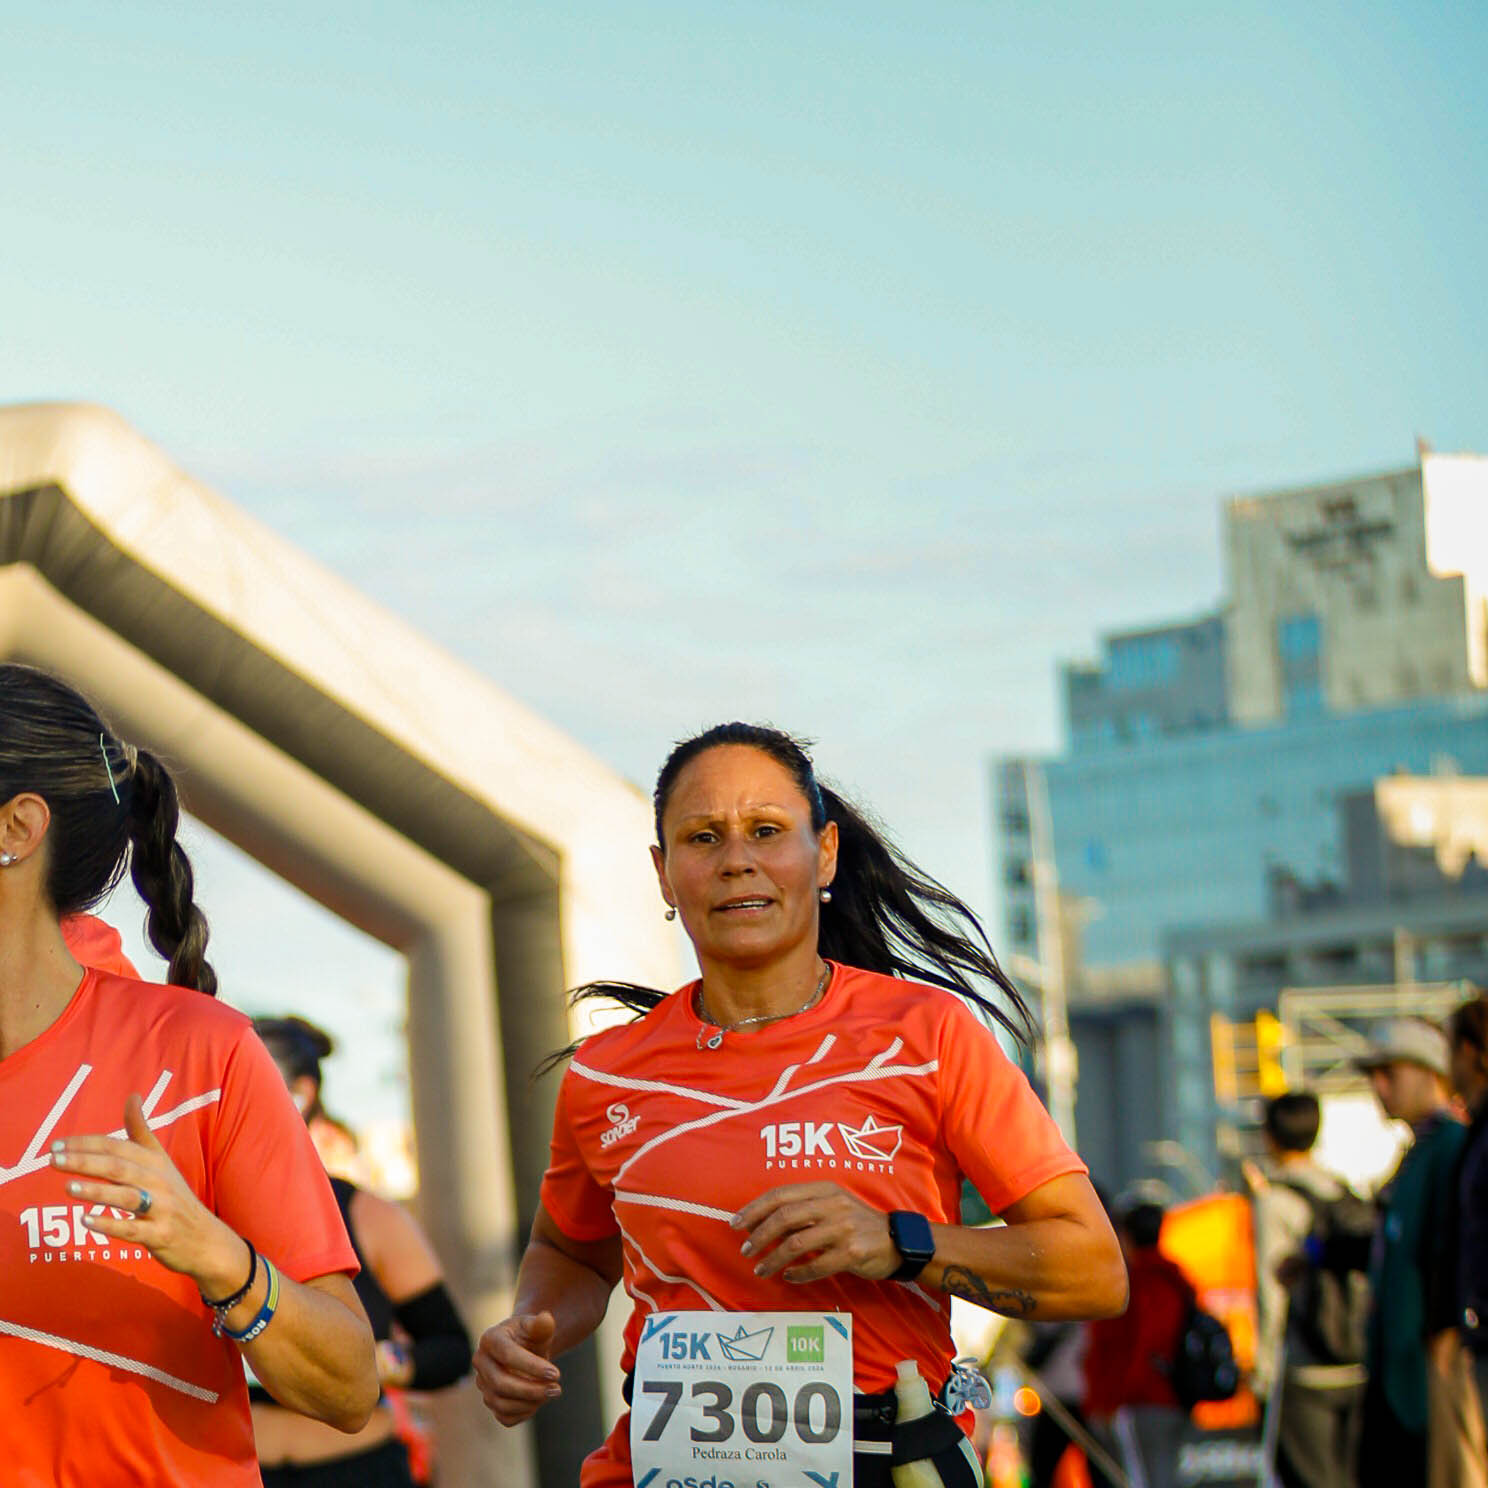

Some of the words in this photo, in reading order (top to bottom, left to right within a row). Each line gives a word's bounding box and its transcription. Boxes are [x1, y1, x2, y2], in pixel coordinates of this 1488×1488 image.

[760, 1122, 836, 1158] 15K
[766, 1159, 836, 1170] PUERTO
[843, 1159, 894, 1175] NORTE
[19, 1204, 110, 1248] 15K
[29, 1250, 111, 1264] PUERTO
[119, 1249, 152, 1260] NO
[659, 1332, 712, 1361] 15K
[790, 1336, 821, 1353] 10K
[642, 1381, 842, 1444] 7300
[692, 1447, 741, 1460] Pedraza
[744, 1447, 788, 1461] Carola
